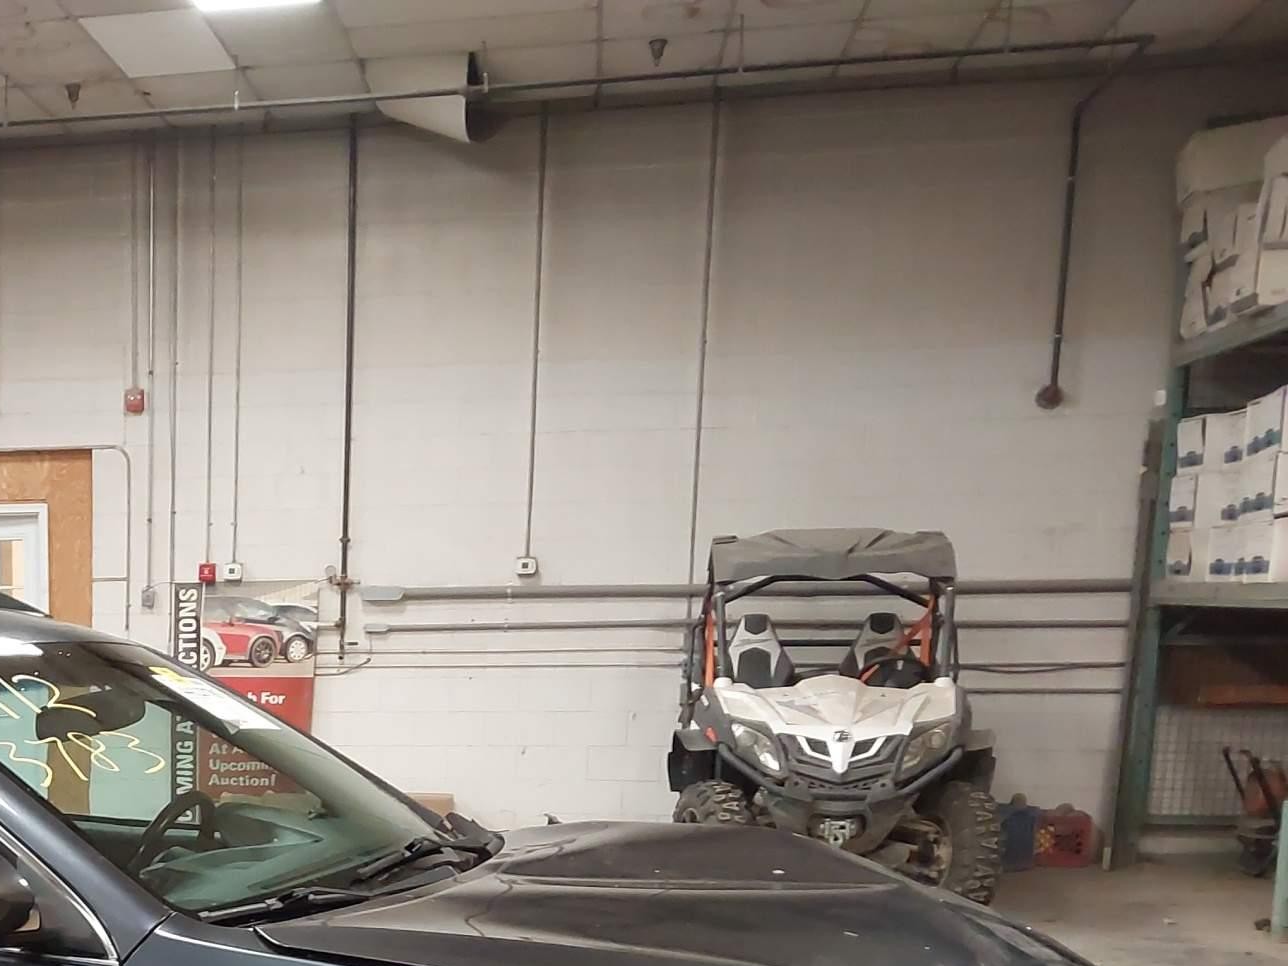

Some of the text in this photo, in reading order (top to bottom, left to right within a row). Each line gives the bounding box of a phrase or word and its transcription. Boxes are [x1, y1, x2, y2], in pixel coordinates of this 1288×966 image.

[261, 691, 287, 706] For
[208, 742, 229, 756] At
[208, 773, 278, 788] Auction!
